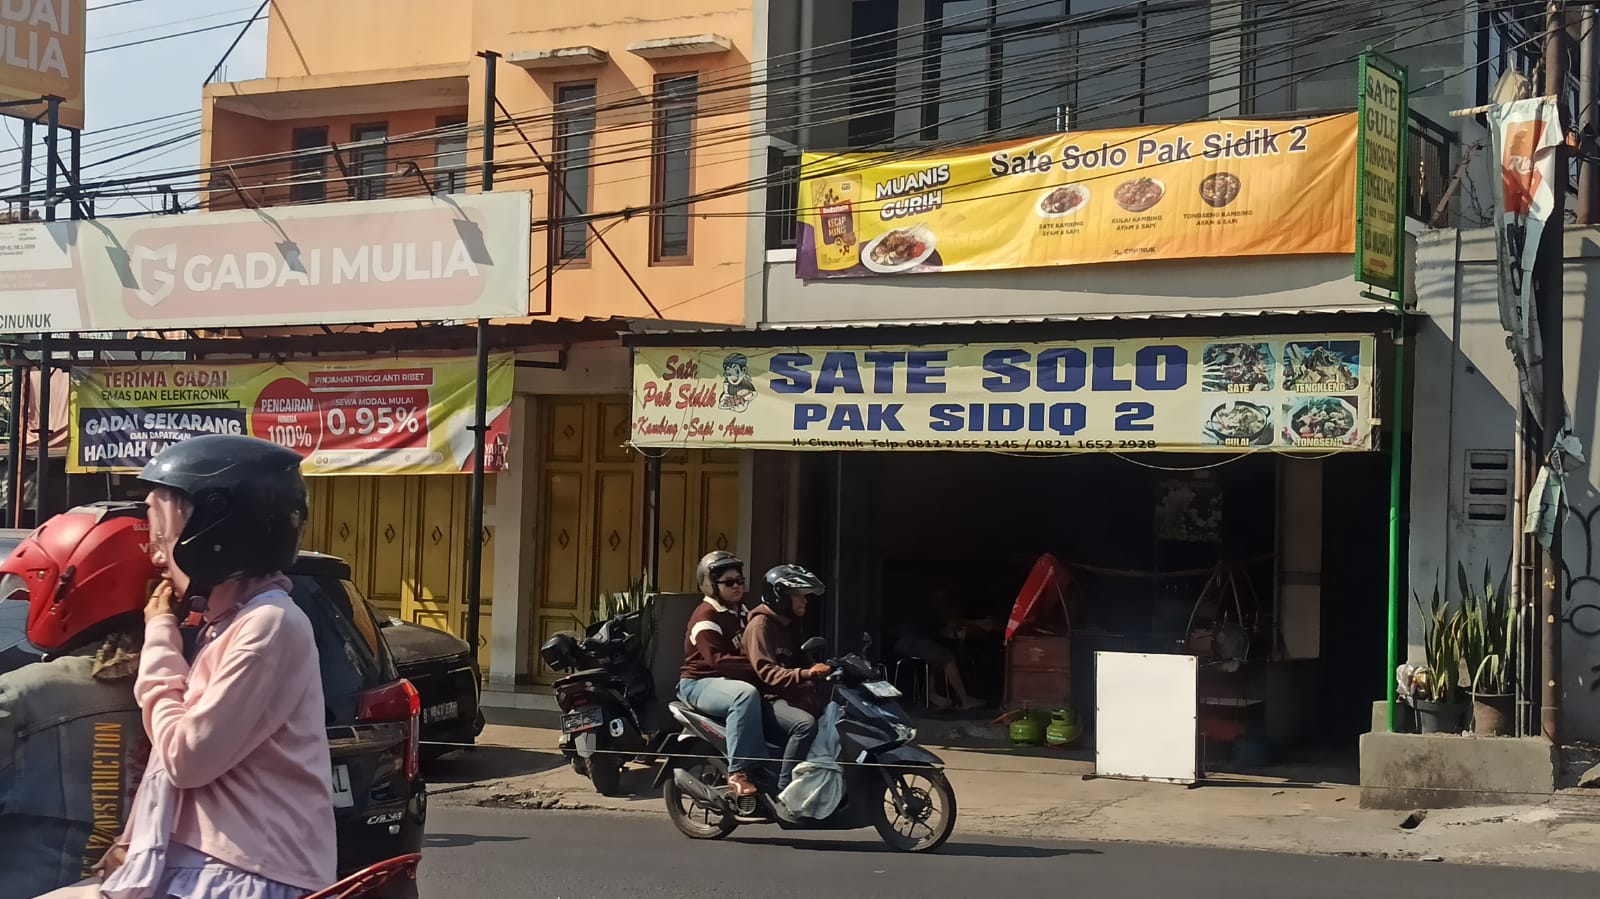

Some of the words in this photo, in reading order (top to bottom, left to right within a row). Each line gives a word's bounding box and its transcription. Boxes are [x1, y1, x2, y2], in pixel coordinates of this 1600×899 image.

[1366, 75, 1397, 111] SATE
[1366, 107, 1397, 143] GULE
[991, 150, 1052, 177] Sate
[1062, 142, 1127, 170] Solo
[1138, 136, 1192, 163] Pak
[1203, 129, 1280, 158] Sidik
[1289, 126, 1308, 151] 2
[876, 164, 950, 199] MUANIS
[880, 190, 942, 219] GURIH
[1039, 222, 1053, 230] SATE
[183, 249, 320, 292] GADAI
[332, 238, 480, 284] MULIA
[104, 369, 168, 388] TERIMA
[173, 369, 228, 388] GADAI
[315, 375, 354, 384] PINJAMAN
[355, 374, 380, 384] TINGGI
[381, 374, 401, 382] ANTI
[402, 373, 425, 381] RIBET
[663, 355, 698, 381] Sate
[769, 351, 948, 394] SATE
[982, 345, 1188, 393] SOLO
[102, 390, 131, 401] EMAS
[134, 390, 157, 400] DAN
[161, 389, 230, 400] ELEKTRONIK
[643, 381, 673, 410] Pak
[675, 382, 718, 410] Sidik
[1227, 383, 1250, 394] SATE
[261, 398, 314, 413] PENCAIRAN
[335, 398, 357, 406] SEWA
[359, 397, 387, 406] MODAL
[389, 396, 414, 405] MULAI
[85, 413, 140, 435] GADAI
[143, 412, 242, 435] SEKARANG
[327, 406, 419, 436] 0.95%
[637, 415, 679, 442] Kambing
[688, 416, 715, 441] Sapi
[722, 416, 754, 444] Ayam
[793, 403, 906, 431] PAK
[929, 402, 1087, 436] SIDIQ
[1114, 402, 1155, 431] 2
[130, 432, 149, 440] DAN
[150, 432, 191, 441] DAPATKAN
[268, 425, 312, 448] 100%
[807, 439, 864, 448] Cinunuk
[871, 438, 903, 450] Telp.
[906, 439, 941, 449] 0812
[943, 439, 981, 449] 2155
[983, 439, 1020, 449] 2145
[1023, 438, 1031, 451] /
[1035, 439, 1074, 449] 0821
[1077, 439, 1115, 449] 1652
[1119, 439, 1157, 449] 2928
[1225, 437, 1250, 447] GULAI
[84, 441, 147, 462] HADIAH
